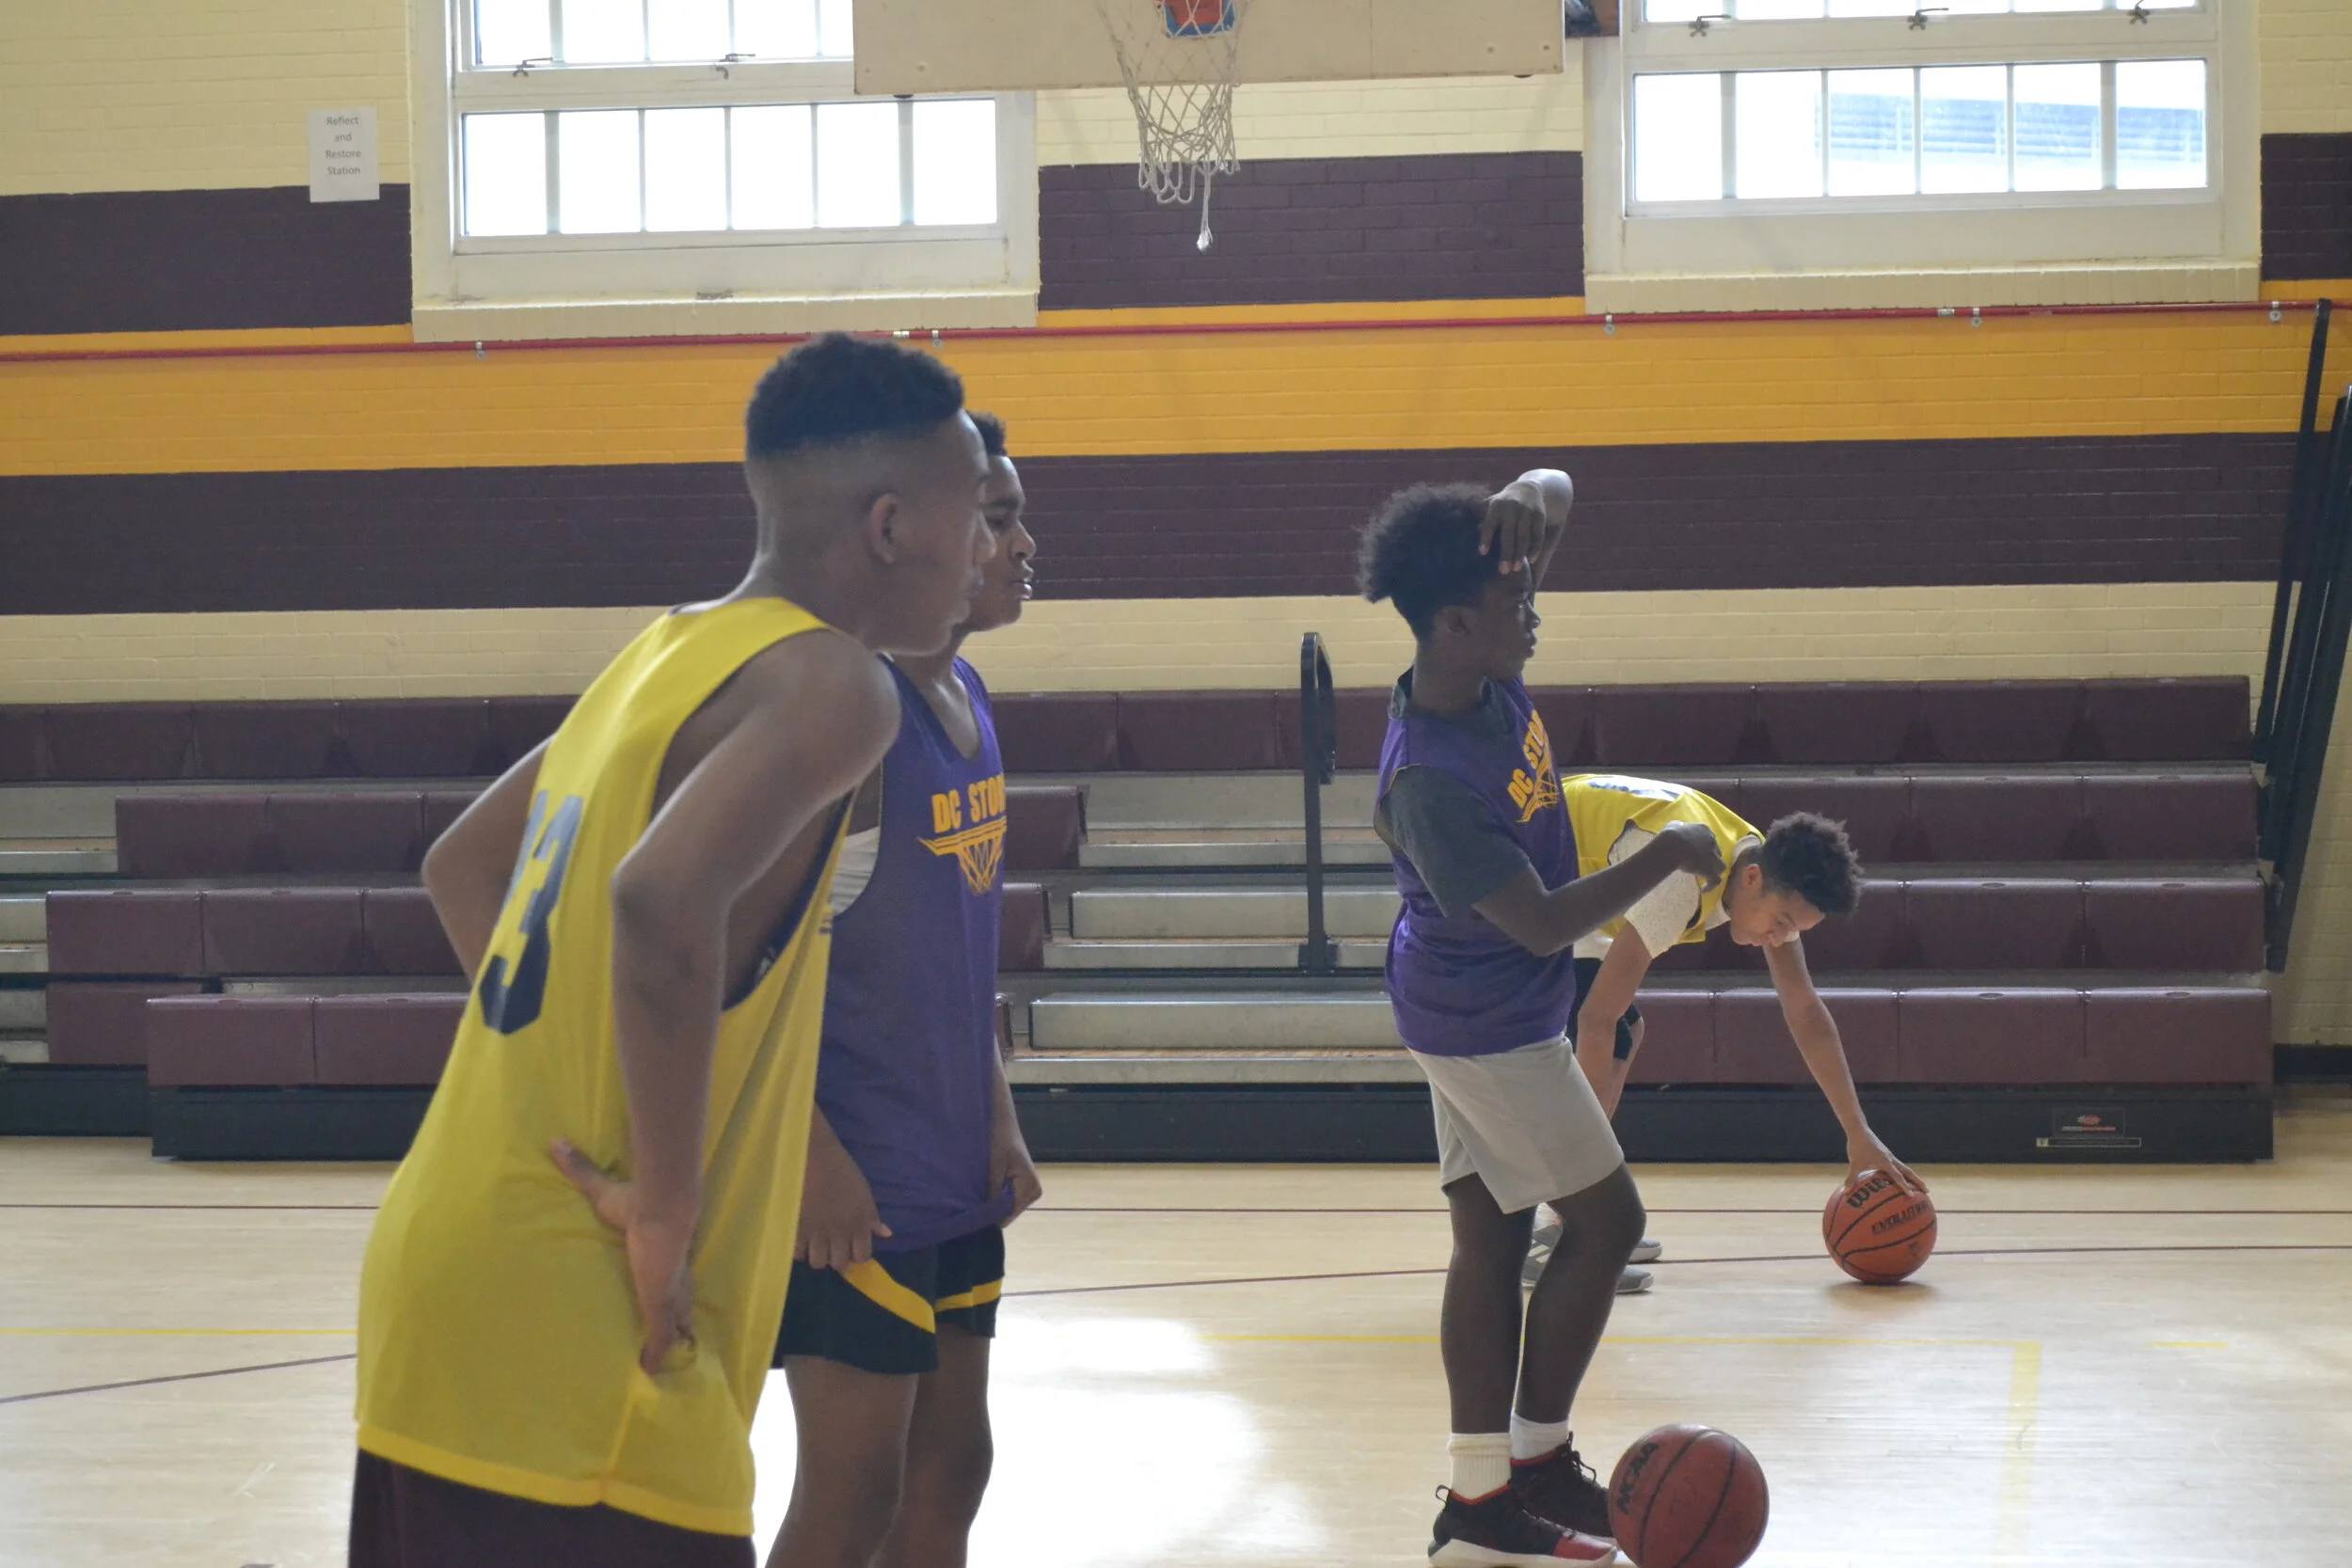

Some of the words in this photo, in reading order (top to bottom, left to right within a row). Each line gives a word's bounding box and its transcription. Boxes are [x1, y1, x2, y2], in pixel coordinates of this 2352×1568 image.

[326, 116, 359, 126] Reflect
[334, 132, 352, 142] and
[326, 150, 362, 159] Restore
[327, 166, 361, 176] Station
[1507, 768, 1534, 809] DC
[1523, 709, 1545, 770] STO
[931, 788, 962, 833] DC
[1616, 1442, 1661, 1516] NCAA
